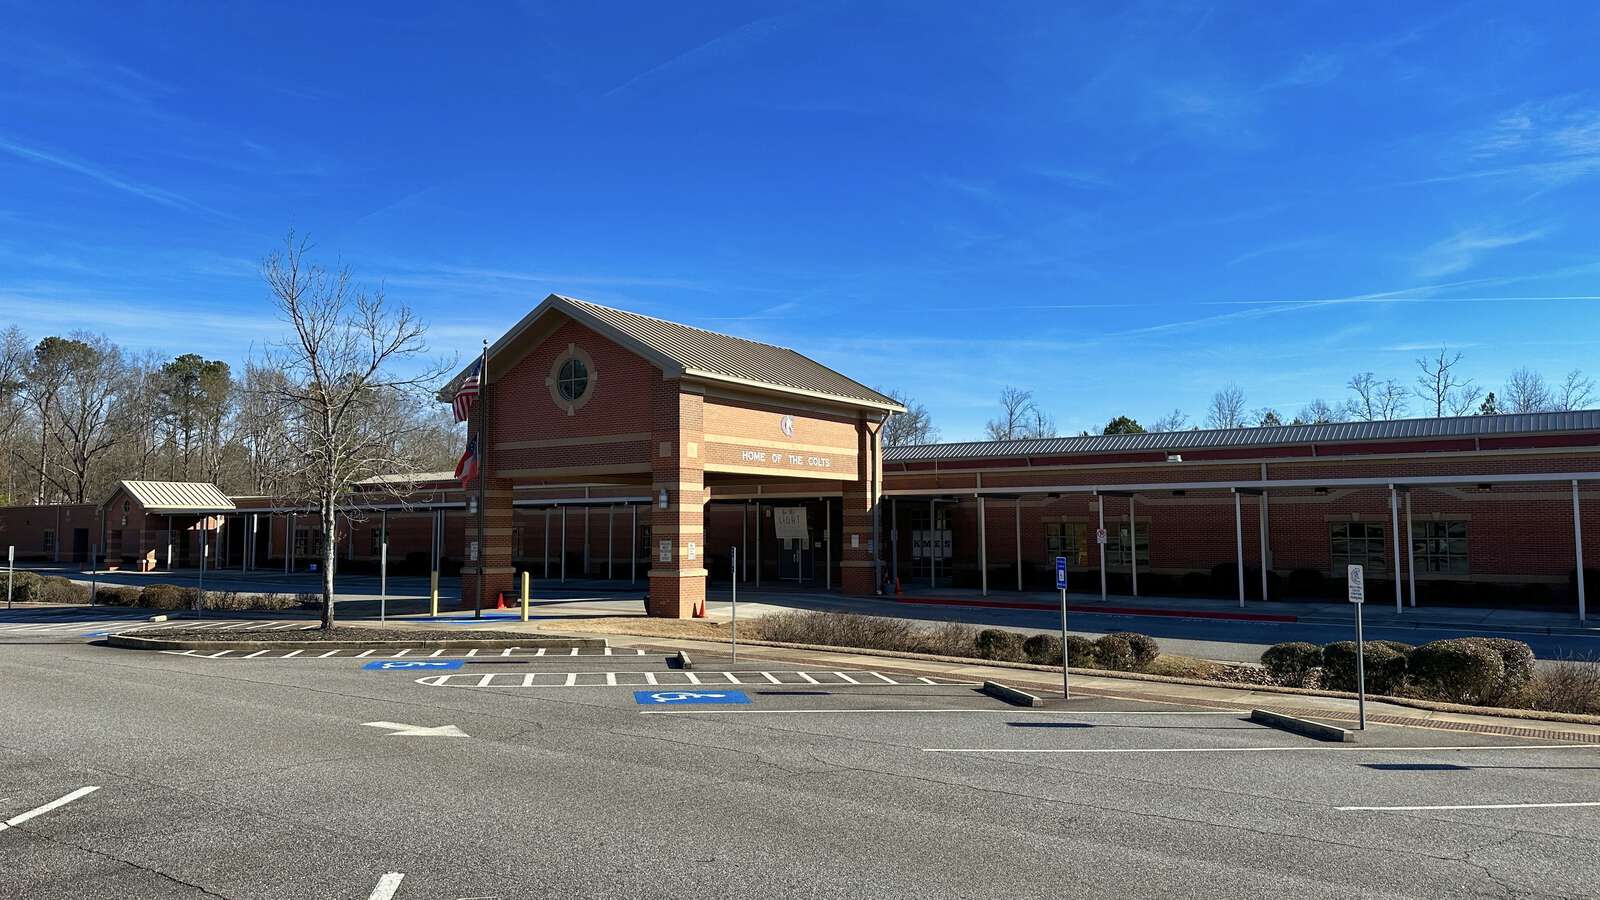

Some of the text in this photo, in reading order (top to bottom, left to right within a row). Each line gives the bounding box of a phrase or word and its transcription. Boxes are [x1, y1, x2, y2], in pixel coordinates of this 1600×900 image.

[742, 450, 831, 467] HOME OF THE COLTS
